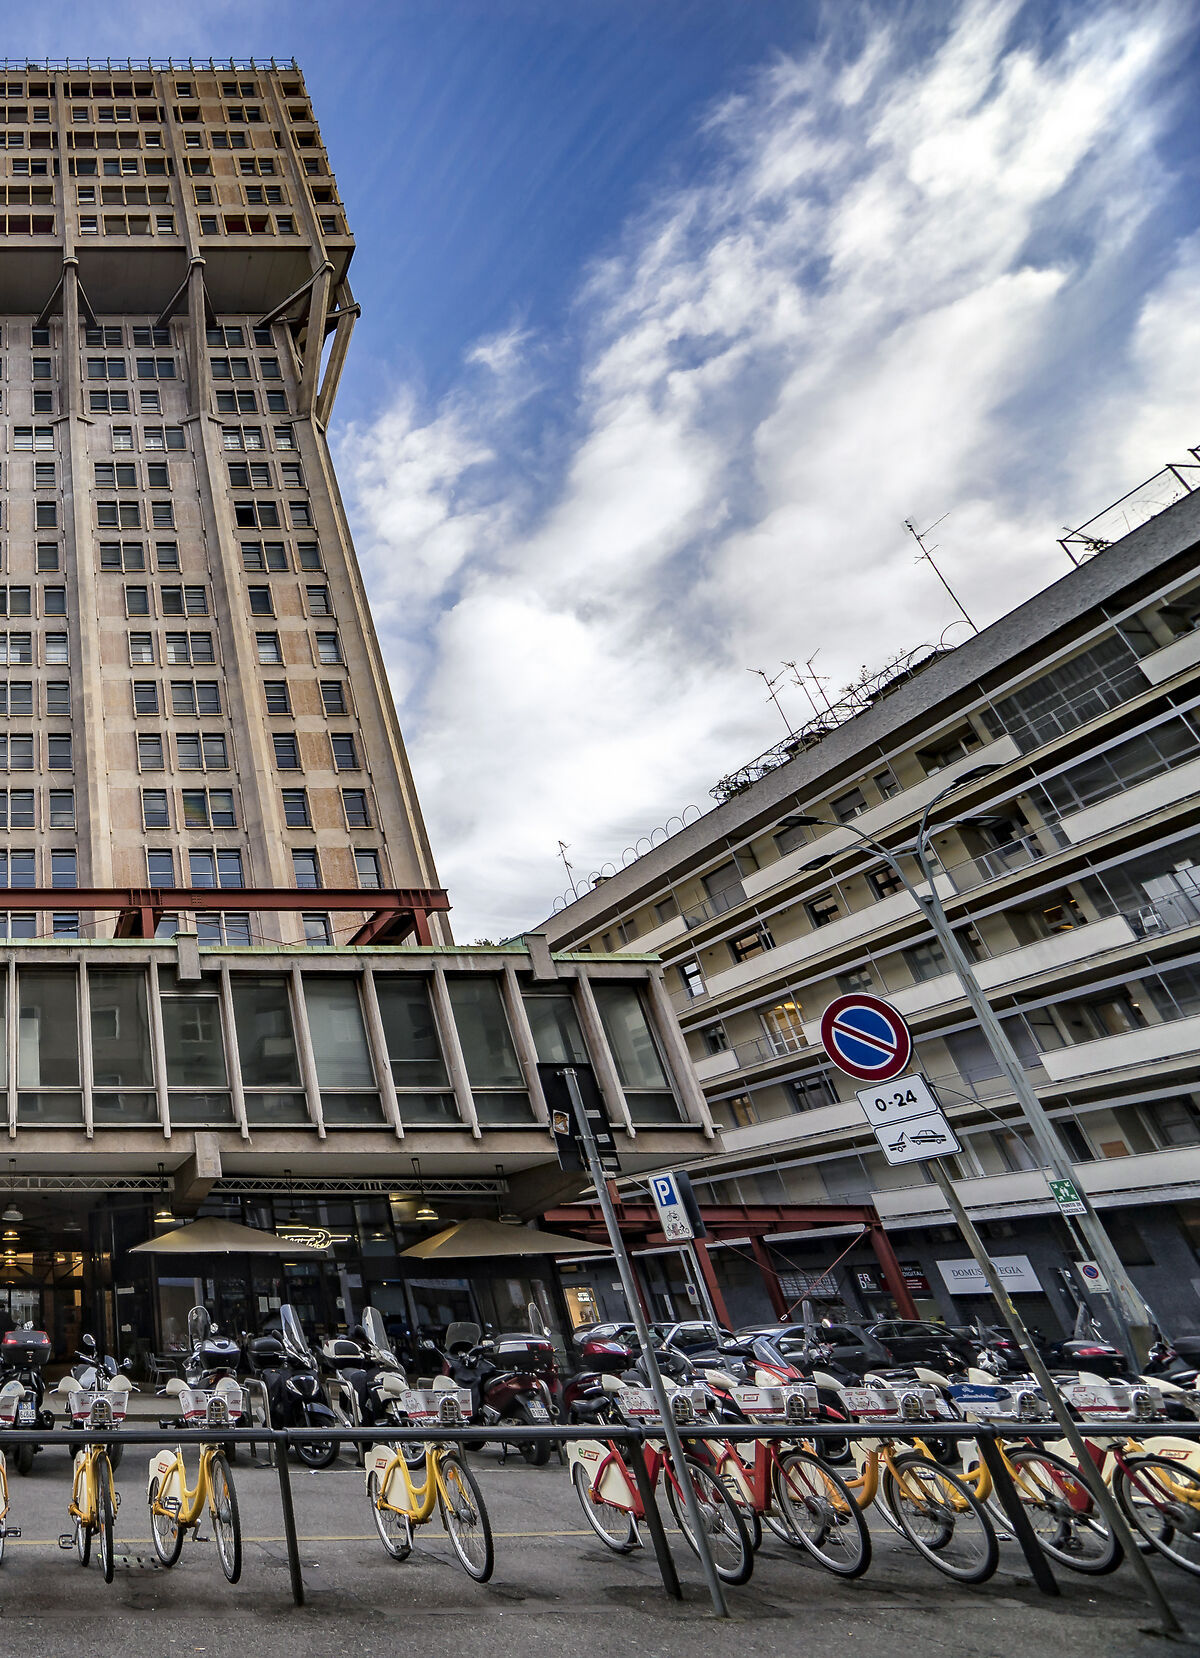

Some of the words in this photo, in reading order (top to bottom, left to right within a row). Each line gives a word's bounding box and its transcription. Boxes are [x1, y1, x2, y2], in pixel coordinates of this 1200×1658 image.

[875, 1089, 918, 1112] 0-24
[655, 1180, 671, 1205] P
[951, 1268, 984, 1277] DOMUS
